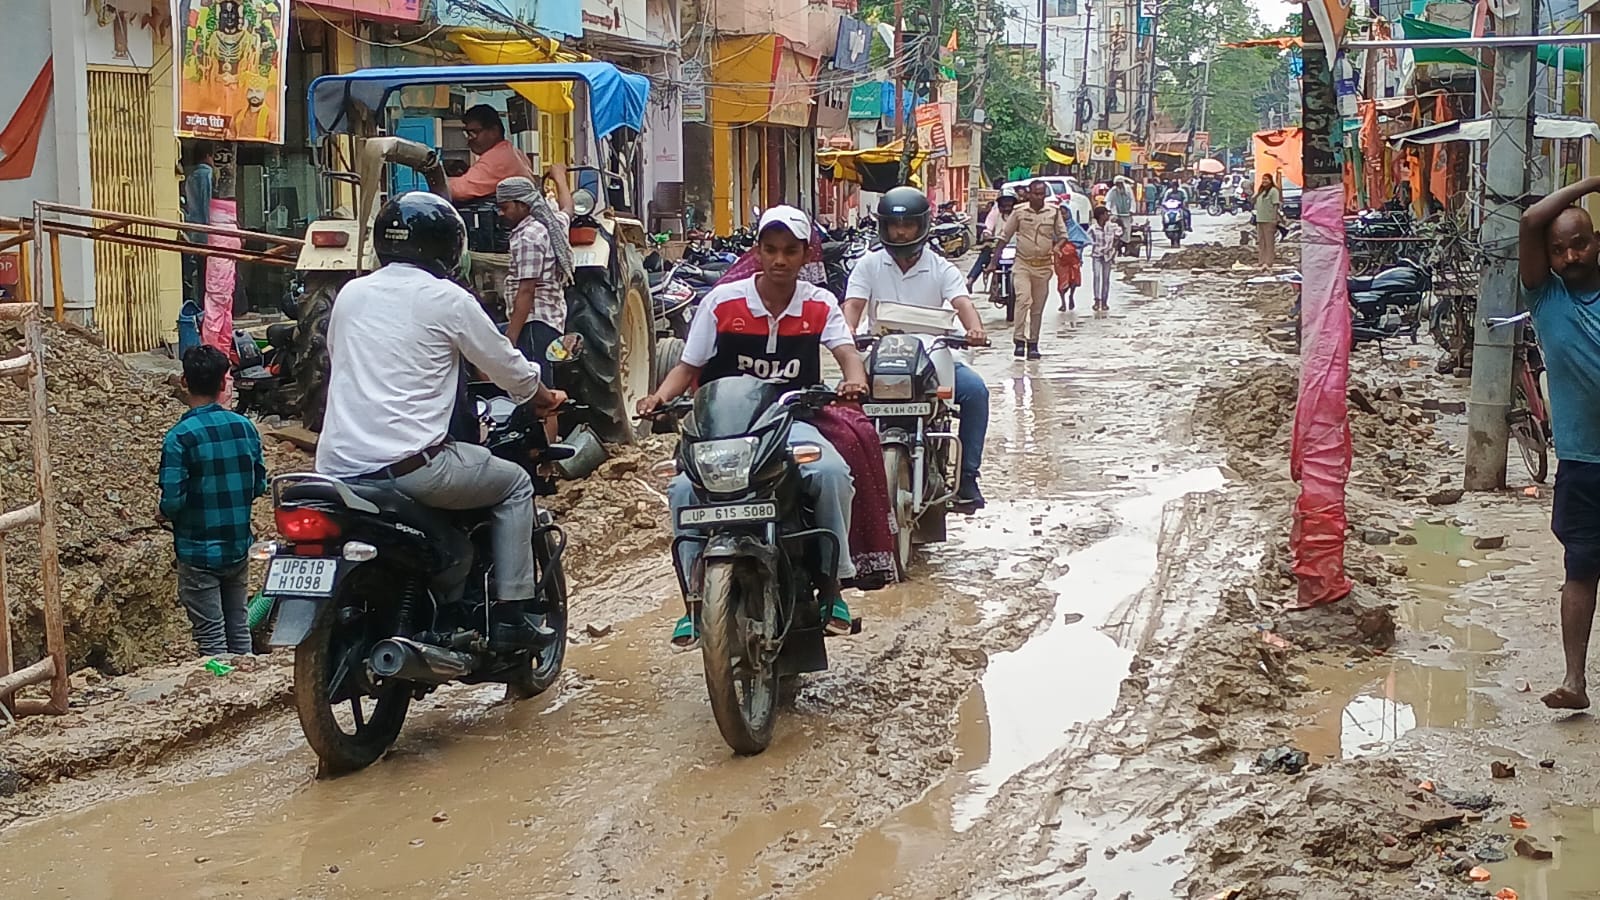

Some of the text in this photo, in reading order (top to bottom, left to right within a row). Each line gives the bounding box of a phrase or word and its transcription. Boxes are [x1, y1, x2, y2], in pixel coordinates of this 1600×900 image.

[737, 354, 801, 379] POLO
[692, 510, 706, 521] UP
[743, 505, 774, 518] 5080
[282, 560, 325, 575] UP61B
[278, 576, 321, 590] H1098
